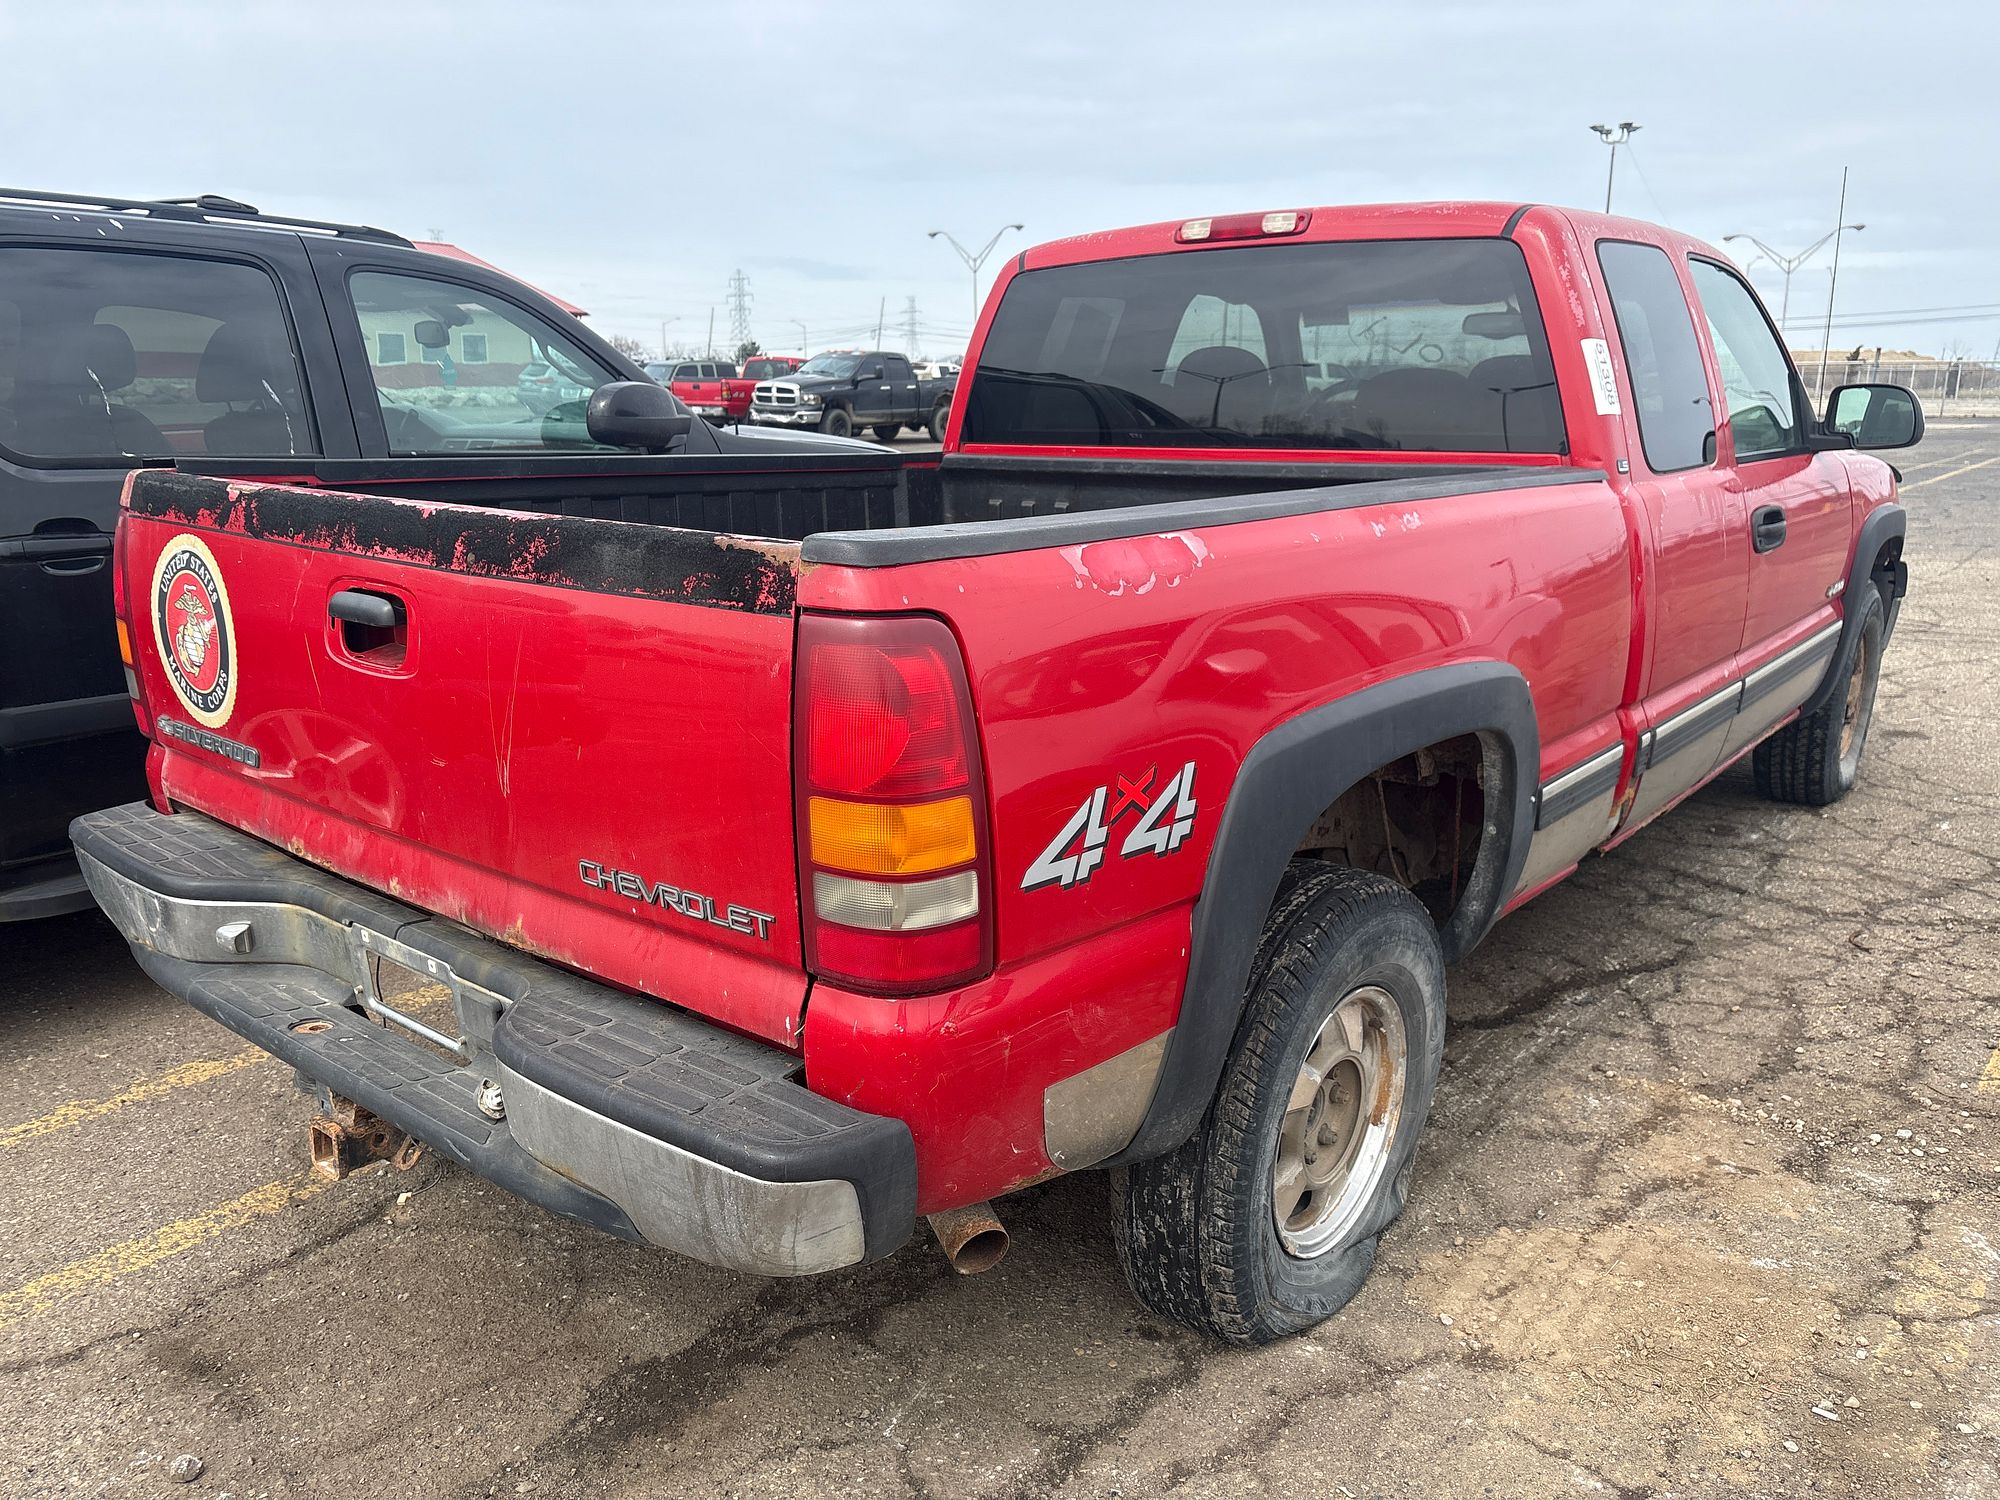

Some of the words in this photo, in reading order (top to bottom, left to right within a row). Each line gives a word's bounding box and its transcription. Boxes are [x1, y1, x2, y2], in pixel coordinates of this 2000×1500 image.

[161, 551, 189, 593] UNITED
[190, 554, 217, 604] STATES
[167, 654, 205, 708] MARINE
[207, 669, 228, 709] CORPS
[173, 722, 260, 768] SILVERADO
[579, 859, 776, 940] CHEVROLET
